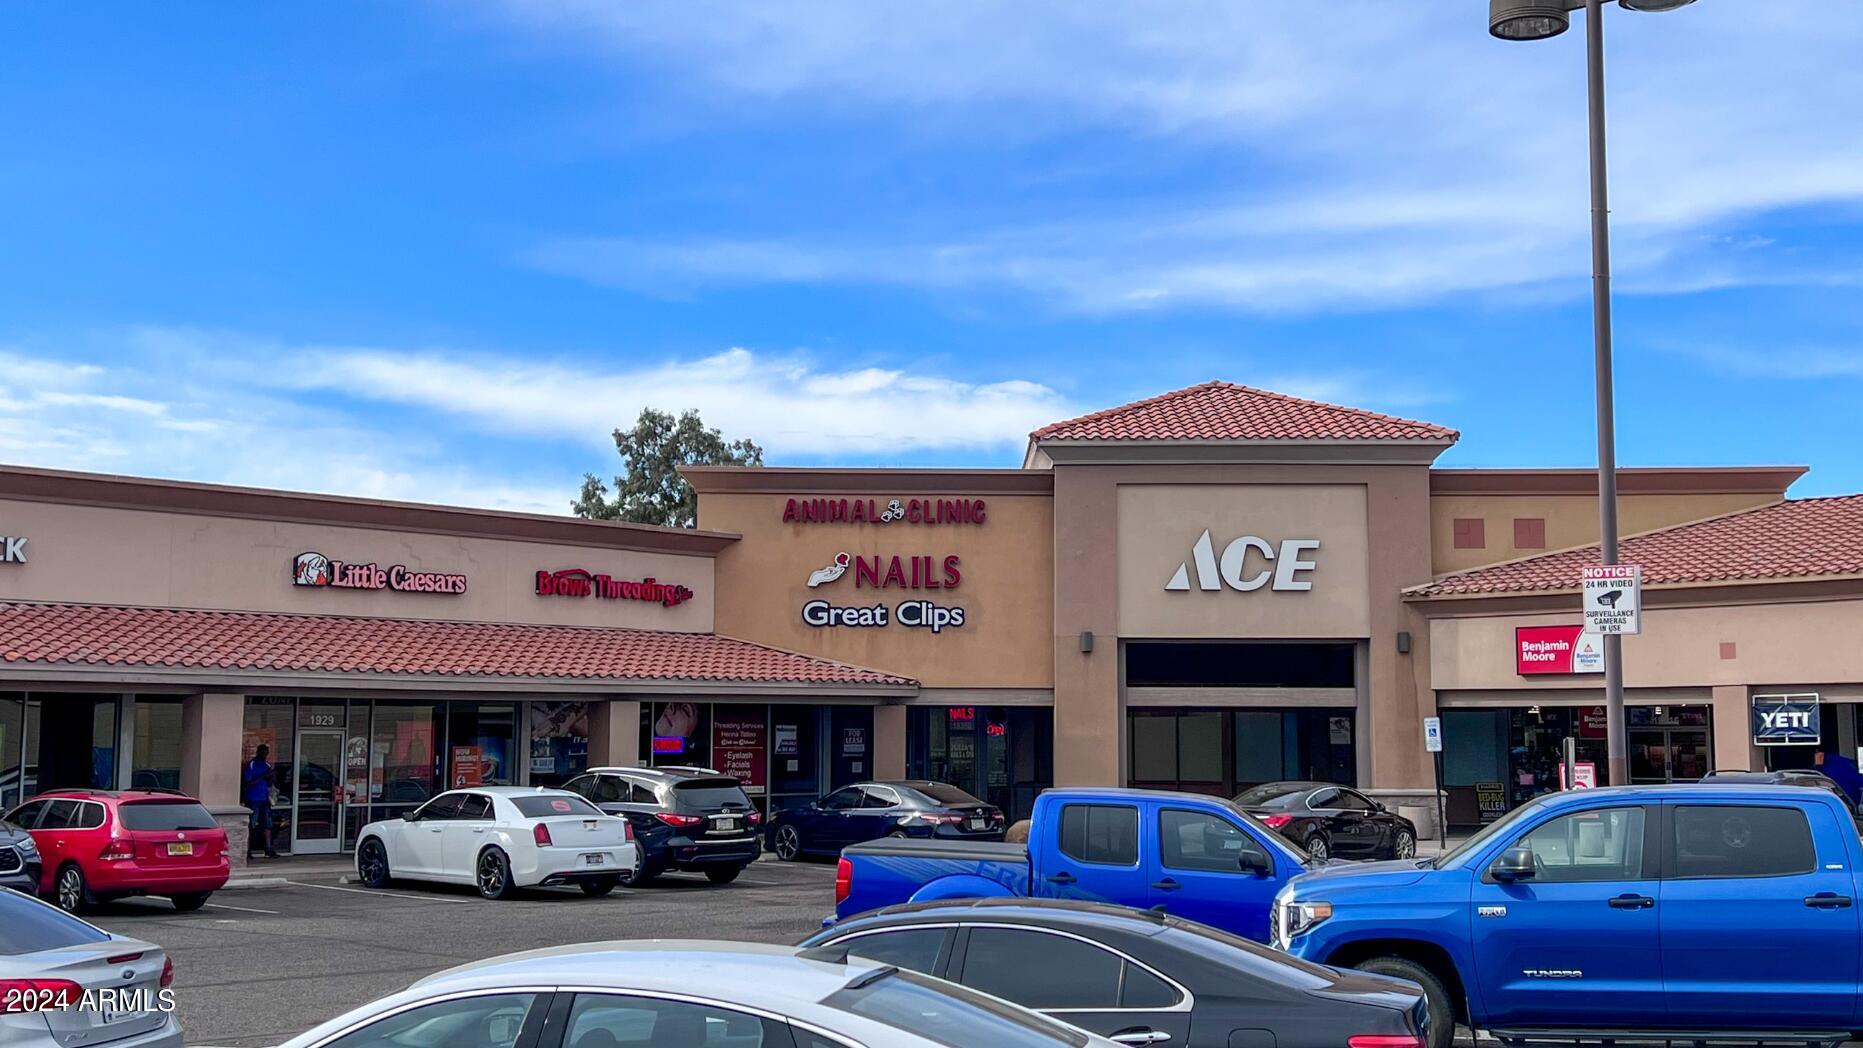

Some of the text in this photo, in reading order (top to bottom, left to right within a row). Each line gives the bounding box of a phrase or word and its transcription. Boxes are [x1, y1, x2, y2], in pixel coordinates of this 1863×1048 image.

[783, 498, 986, 524] ANIMAL CLINIC
[1164, 528, 1320, 591] ACE
[855, 555, 961, 588] NAILS
[1584, 567, 1634, 578] NOTICE
[331, 560, 466, 594] Little Caesars
[536, 569, 592, 597] Brows
[593, 574, 678, 607] Threading
[1597, 580, 1608, 588] HR
[1610, 579, 1633, 588] VIDEO
[803, 601, 965, 633] Great Clips
[1585, 610, 1634, 618] SURVEILLANCE
[1522, 640, 1569, 653] Benjamin
[1522, 652, 1556, 661] Moore
[310, 715, 335, 725] 1929
[1761, 712, 1809, 728] YETI
[714, 722, 740, 730] Threading
[727, 752, 753, 760] Eyelash
[348, 758, 367, 766] OPEN
[727, 770, 752, 778] Waxing
[1480, 802, 1505, 810] KILLER
[1523, 970, 1582, 978] TUNDRA
